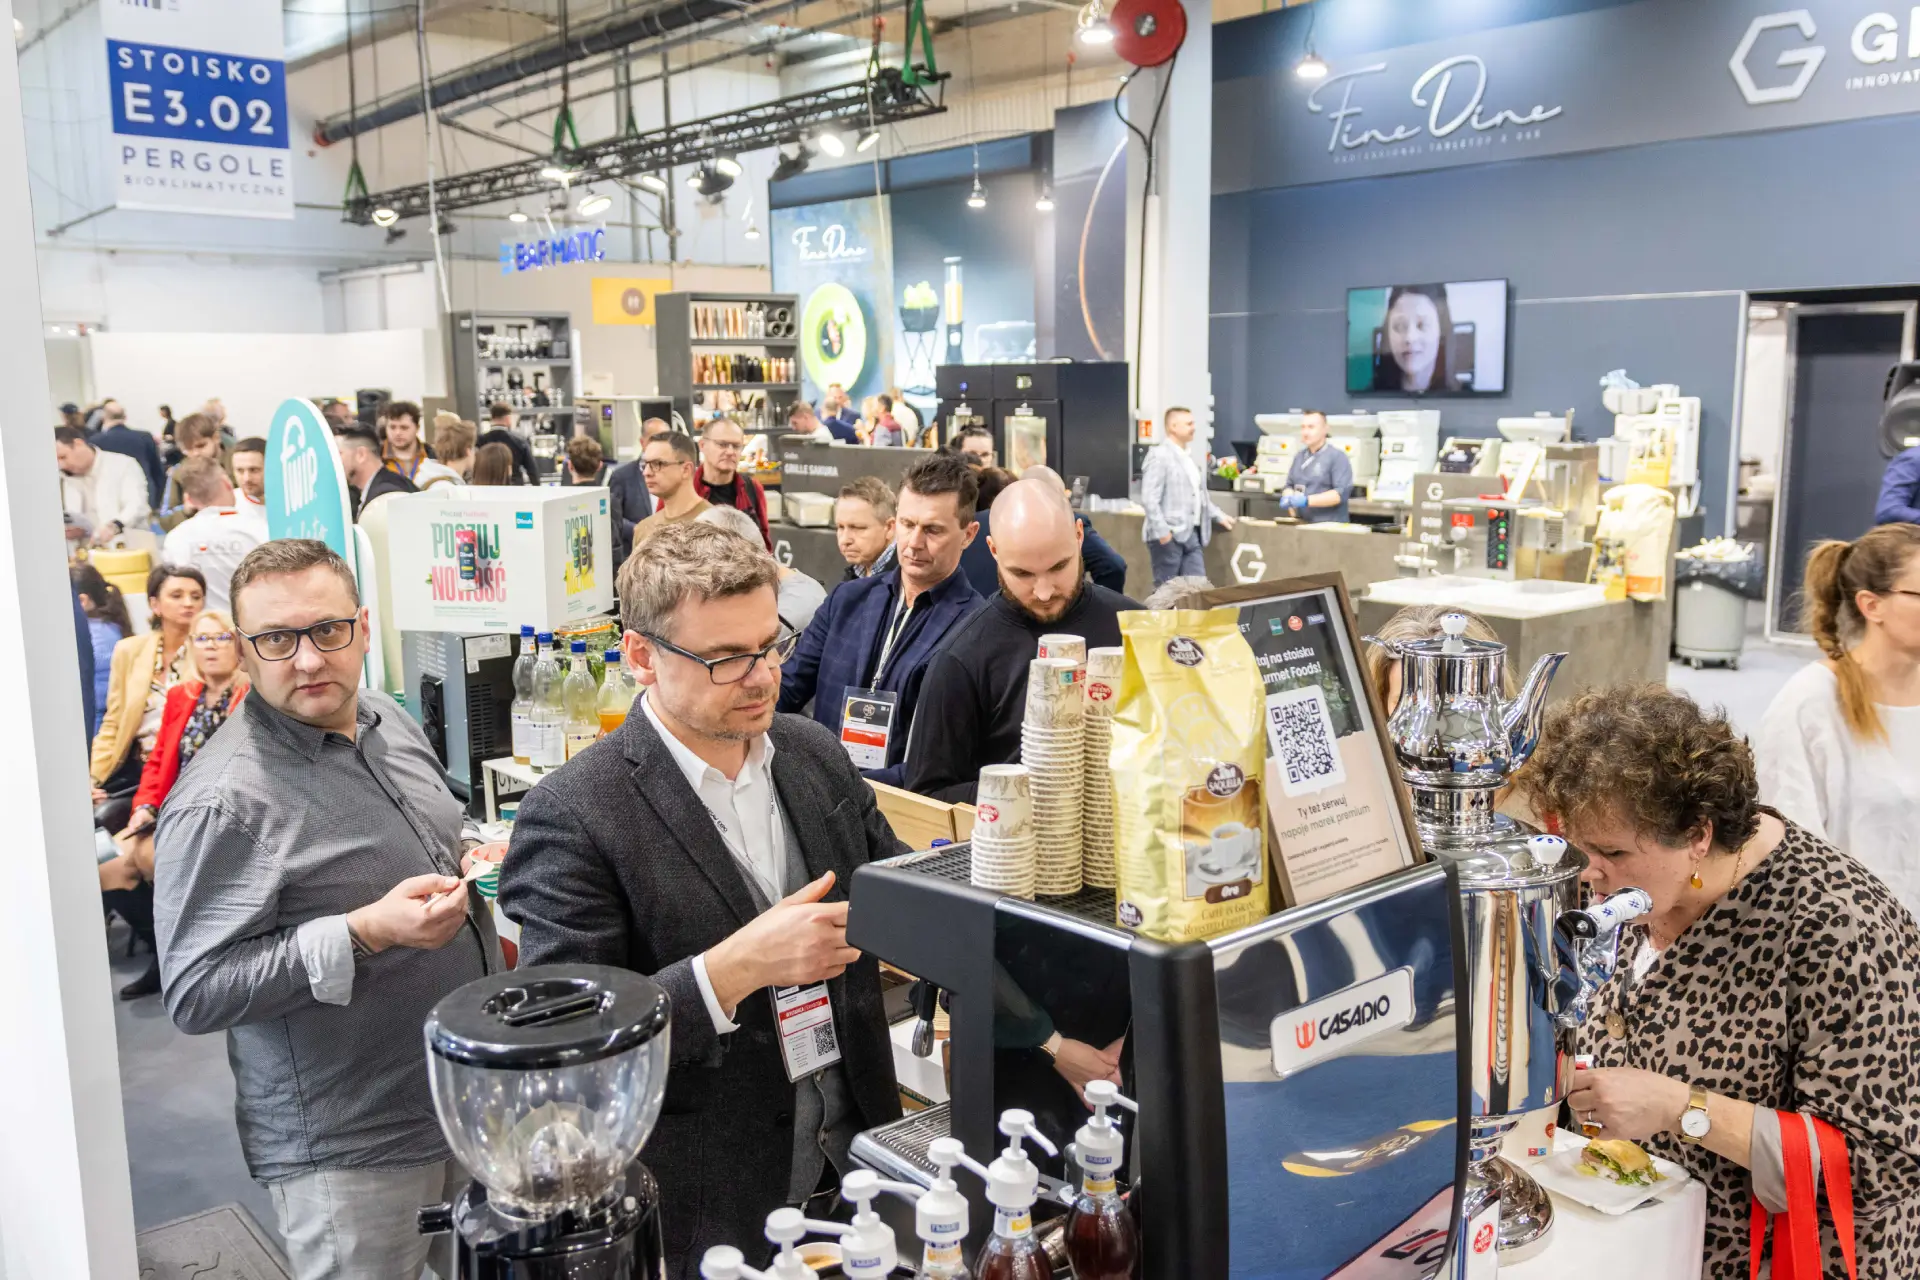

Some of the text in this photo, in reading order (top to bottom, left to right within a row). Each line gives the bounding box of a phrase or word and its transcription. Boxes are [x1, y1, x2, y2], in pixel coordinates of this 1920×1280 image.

[117, 47, 272, 85] STOISKO
[123, 82, 275, 135] E3.02
[121, 145, 286, 178] PERGOLE
[123, 174, 286, 196] BIOKLIMATYCZNE
[430, 523, 500, 559] POUJ
[1255, 646, 1315, 668] taj na stoisku
[1263, 661, 1322, 684] urmet Foods!
[1280, 804, 1371, 840] napoje marek premium
[1297, 794, 1348, 820] Ty też serwuj
[1318, 994, 1390, 1041] CASADIO
